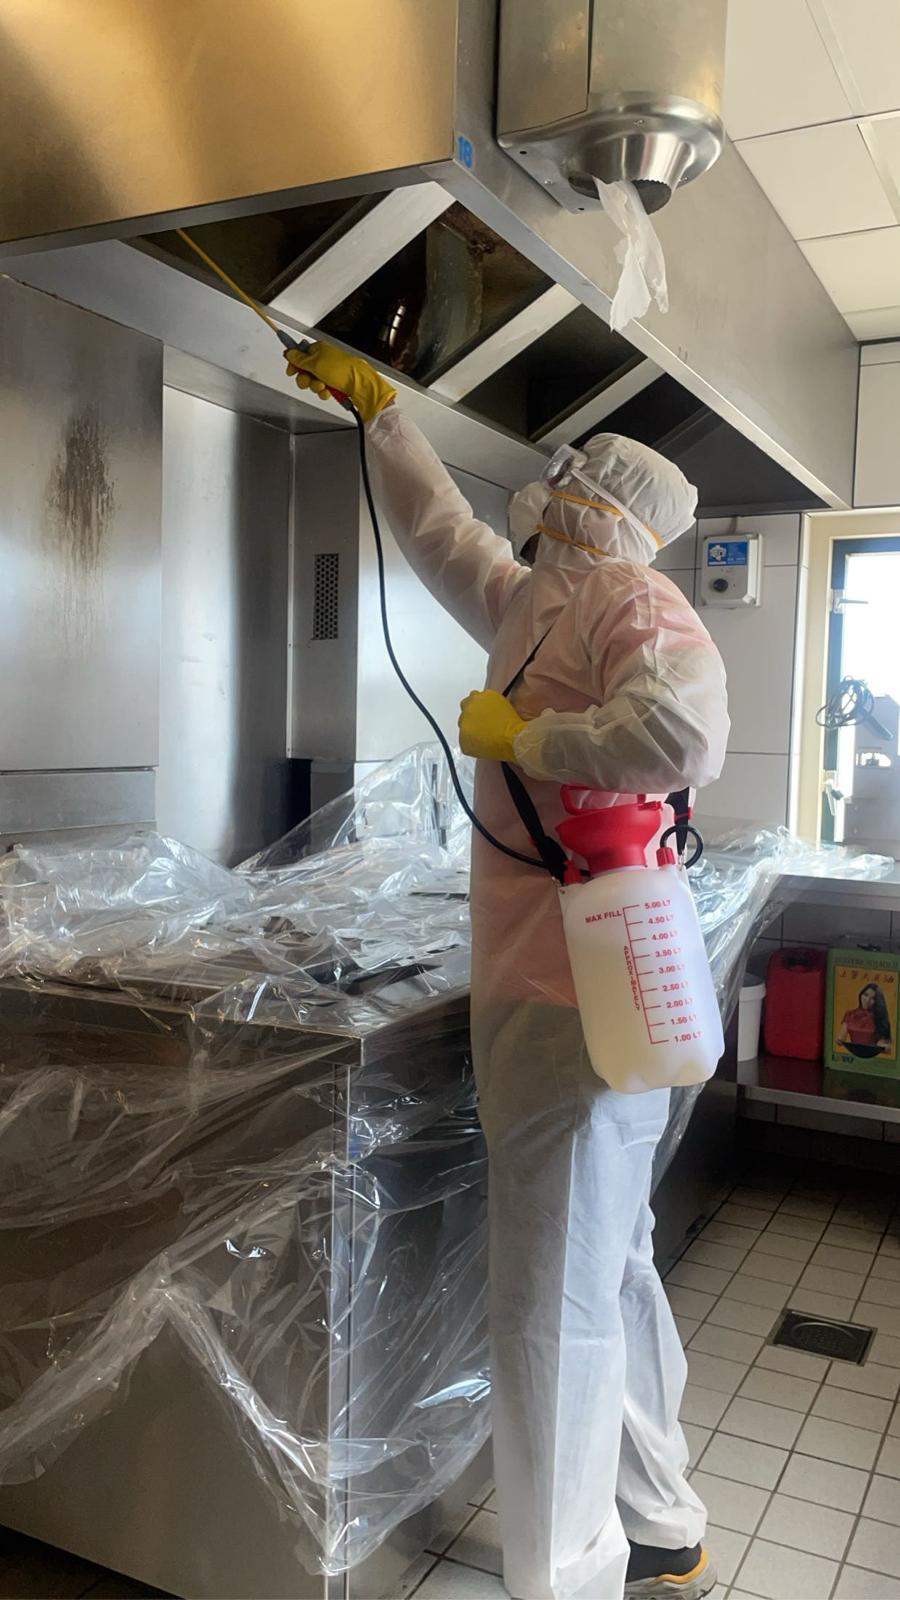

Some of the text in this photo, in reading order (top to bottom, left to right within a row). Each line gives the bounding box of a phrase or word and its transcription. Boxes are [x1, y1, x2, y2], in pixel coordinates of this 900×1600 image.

[457, 135, 473, 168] 18
[644, 901, 661, 909] 5.00
[585, 910, 622, 923] MAX FILL
[648, 916, 665, 924] 4.50
[651, 932, 669, 940] 4.00
[655, 949, 672, 957] 3.50
[659, 965, 676, 974] 3.00
[662, 983, 680, 992] 2.50
[666, 1000, 684, 1008] 2.00
[671, 1016, 688, 1025] 1.50
[675, 1034, 692, 1042] 1.00
